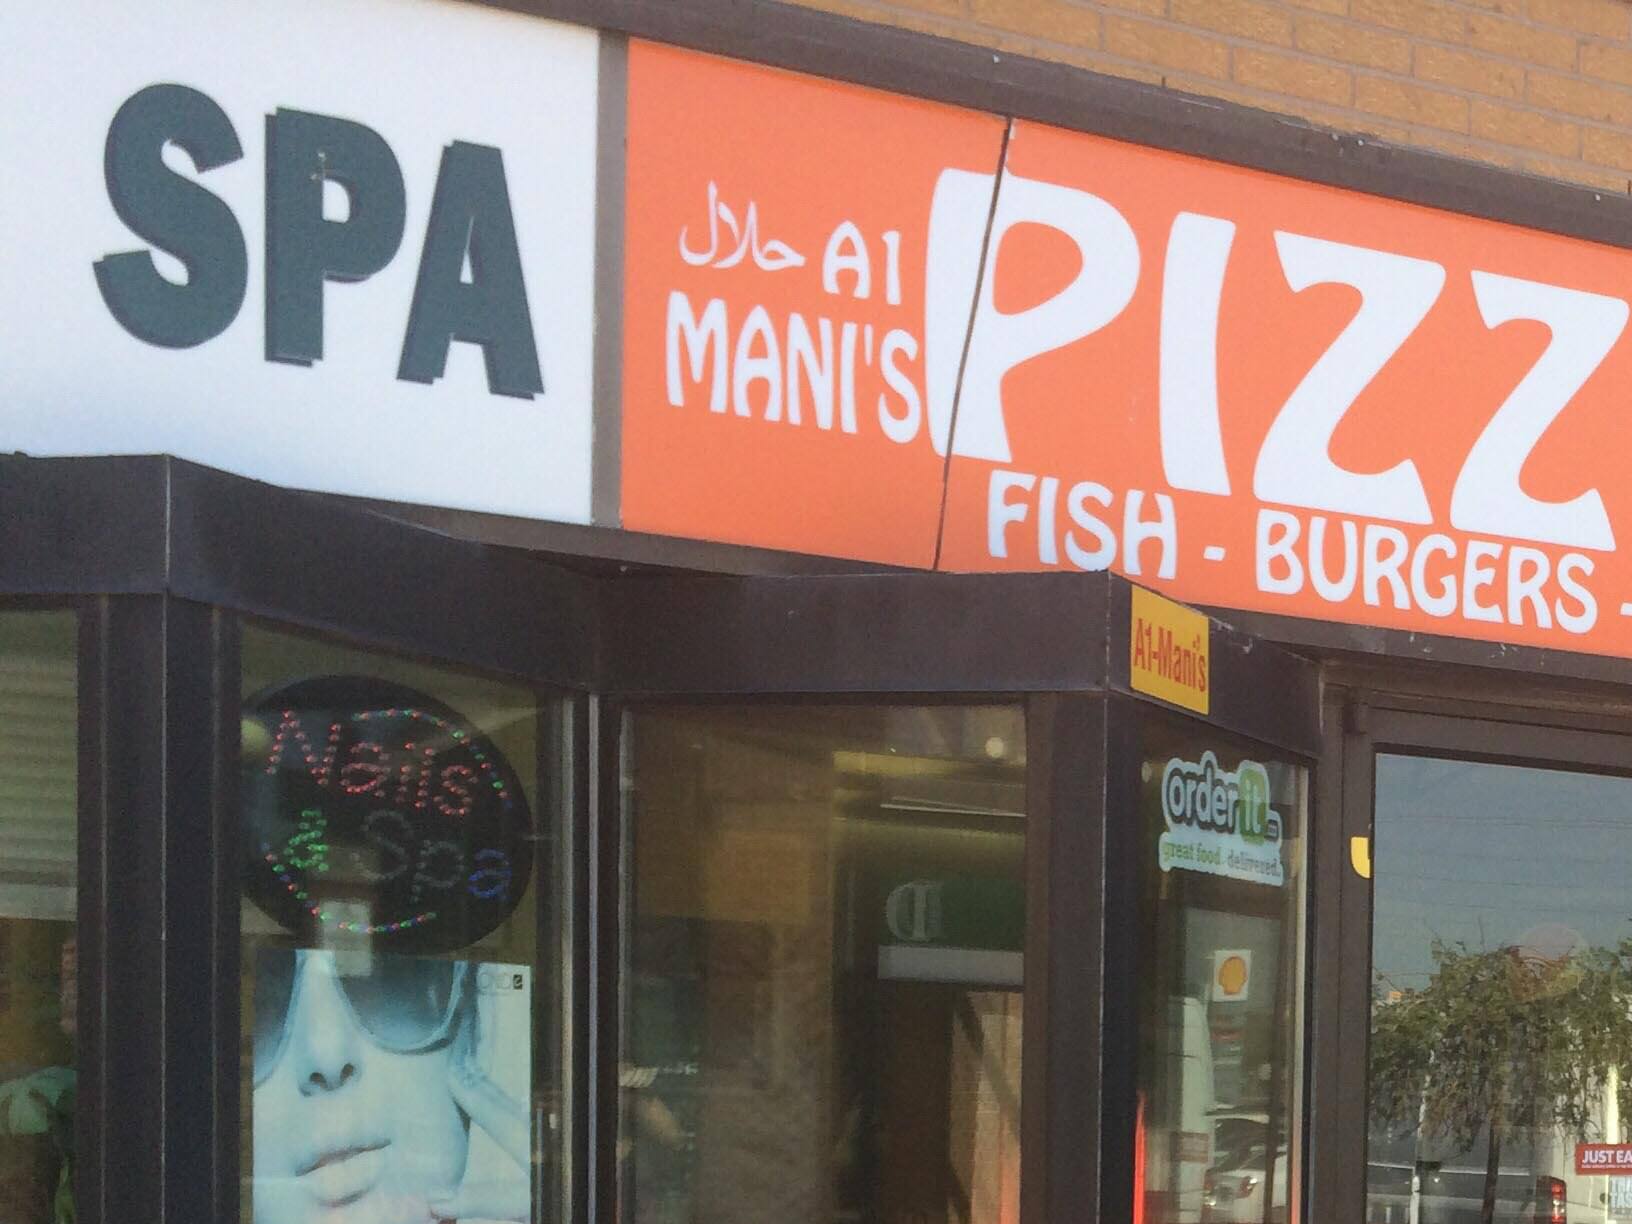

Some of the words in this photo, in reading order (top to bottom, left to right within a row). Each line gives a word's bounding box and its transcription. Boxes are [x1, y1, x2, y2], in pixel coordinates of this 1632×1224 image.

[91, 82, 546, 401] SPA
[679, 180, 806, 272] حلال
[665, 290, 922, 444] MANI'S
[987, 469, 1178, 580] FISH
[1255, 508, 1599, 635] BURGERS
[1134, 617, 1207, 693] A1-Mani's
[264, 709, 480, 817] Nails
[350, 808, 513, 903] Spa
[1582, 1149, 1614, 1163] JUST
